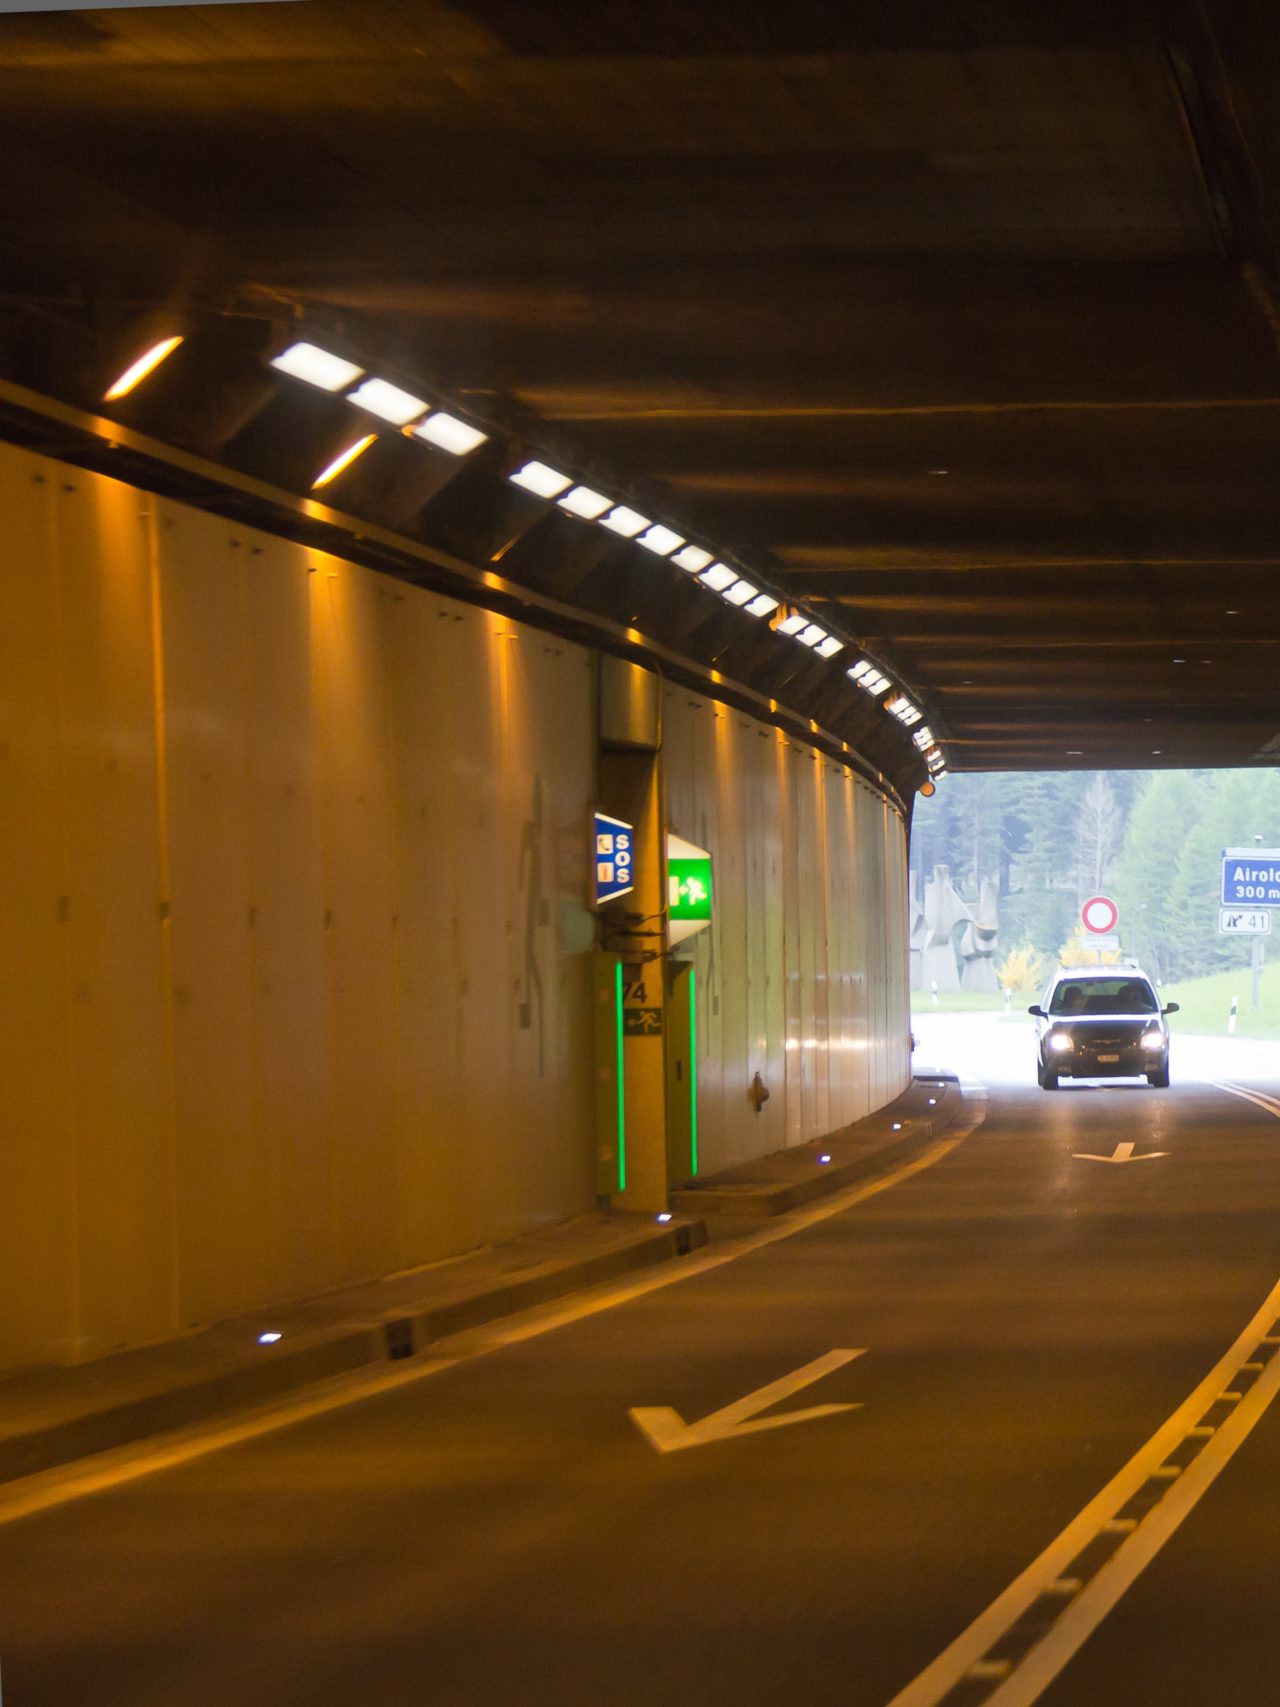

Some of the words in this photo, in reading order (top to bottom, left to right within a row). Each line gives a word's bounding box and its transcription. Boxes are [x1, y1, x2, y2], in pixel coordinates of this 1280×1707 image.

[615, 834, 631, 884] SOS
[1235, 886, 1265, 899] 300
[1268, 889, 1280, 899] m
[1248, 915, 1264, 929] 41
